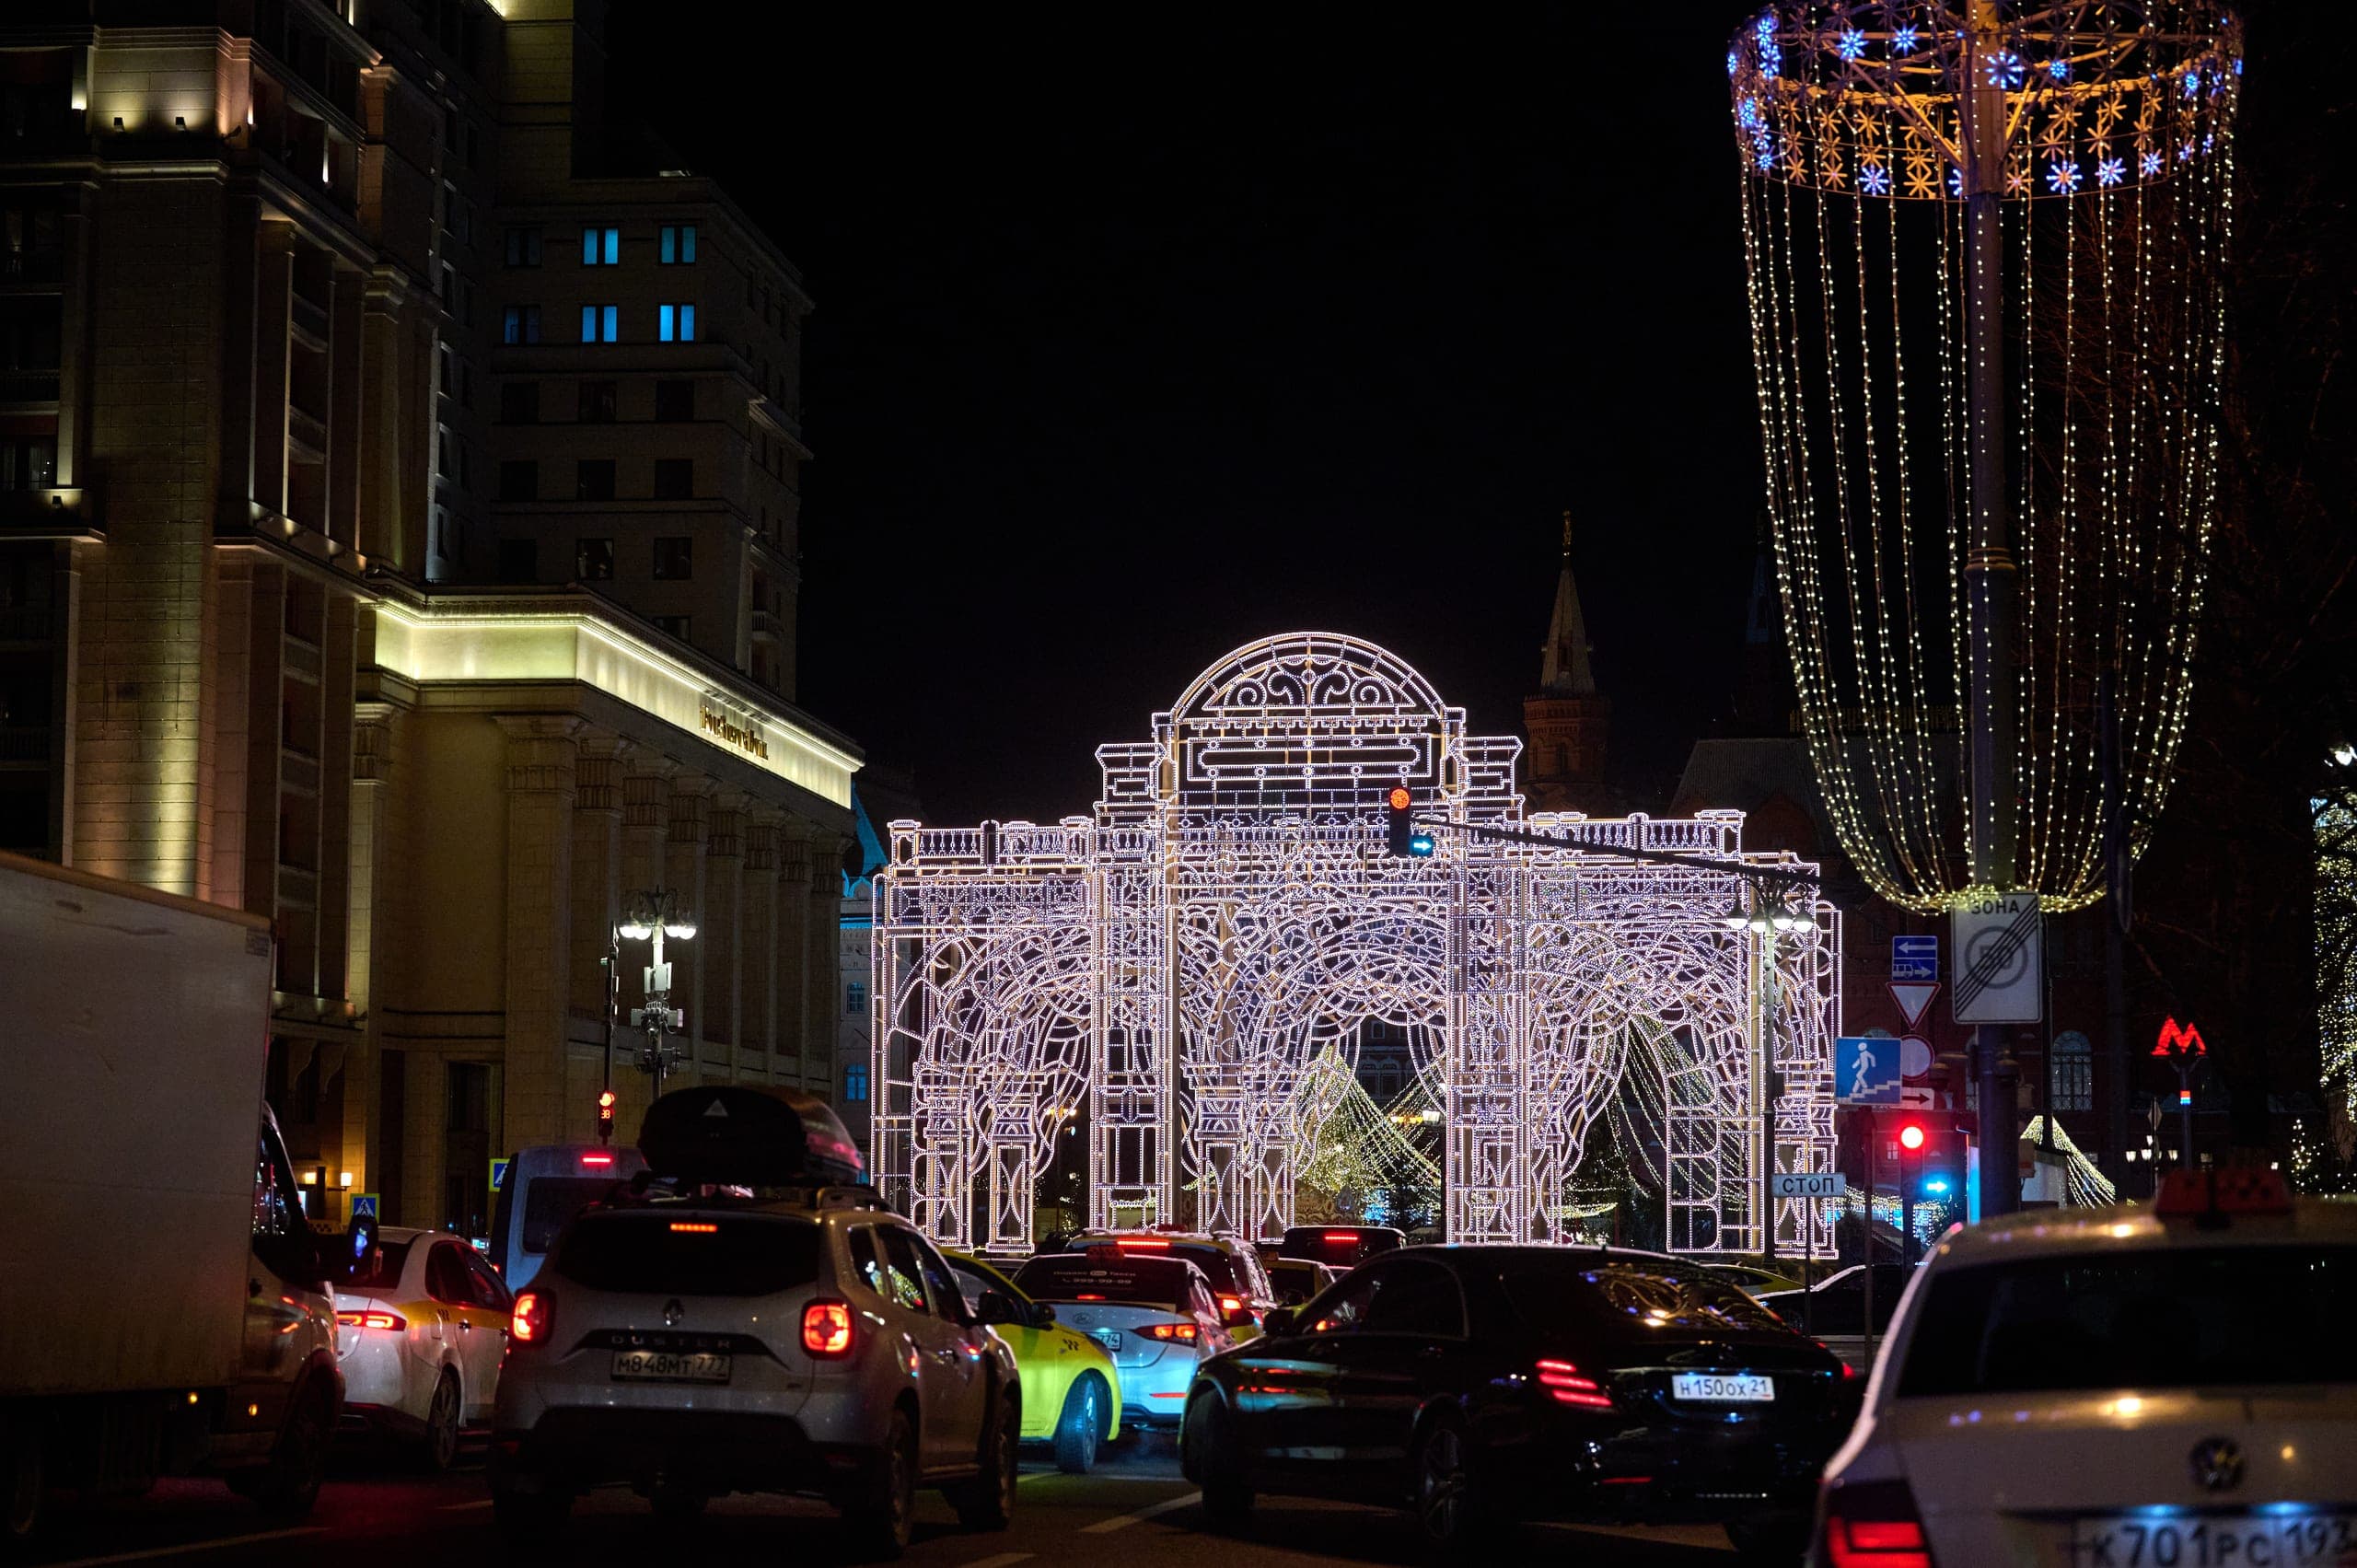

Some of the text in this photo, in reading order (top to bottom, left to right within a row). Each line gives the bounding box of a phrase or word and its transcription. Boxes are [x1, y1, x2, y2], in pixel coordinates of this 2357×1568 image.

[1971, 900, 2020, 914] ЗОНА
[1782, 1178, 1834, 1193] СТОП
[1750, 1379, 1768, 1392] 21
